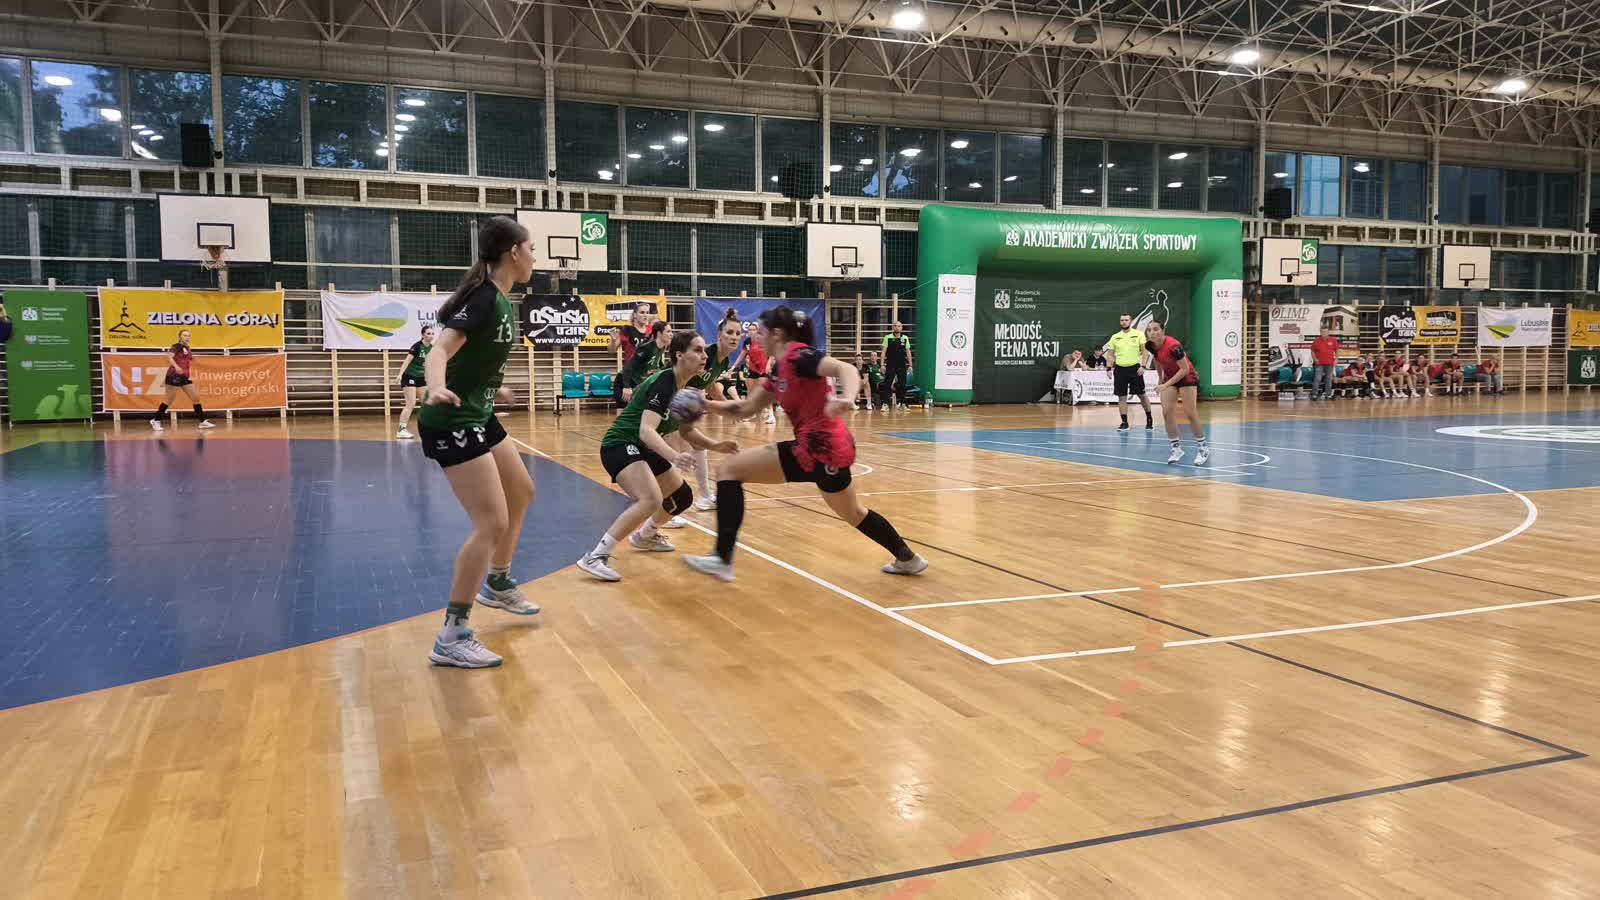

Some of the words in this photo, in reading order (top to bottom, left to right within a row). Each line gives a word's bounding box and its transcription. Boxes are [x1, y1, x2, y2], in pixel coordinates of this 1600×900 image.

[1023, 230, 1087, 248] AKADEMICKI
[1091, 233, 1138, 251] ZWIĄZEK
[1143, 234, 1197, 250] SPORTOWY
[147, 312, 221, 325] ZIELONA
[1272, 307, 1309, 319] OLIMP
[494, 323, 513, 342] 13
[995, 321, 1042, 340] MŁODOŚĆ
[994, 341, 1028, 357] PEŁNA
[1031, 341, 1059, 357] PASJI
[199, 382, 279, 397] elonogórski
